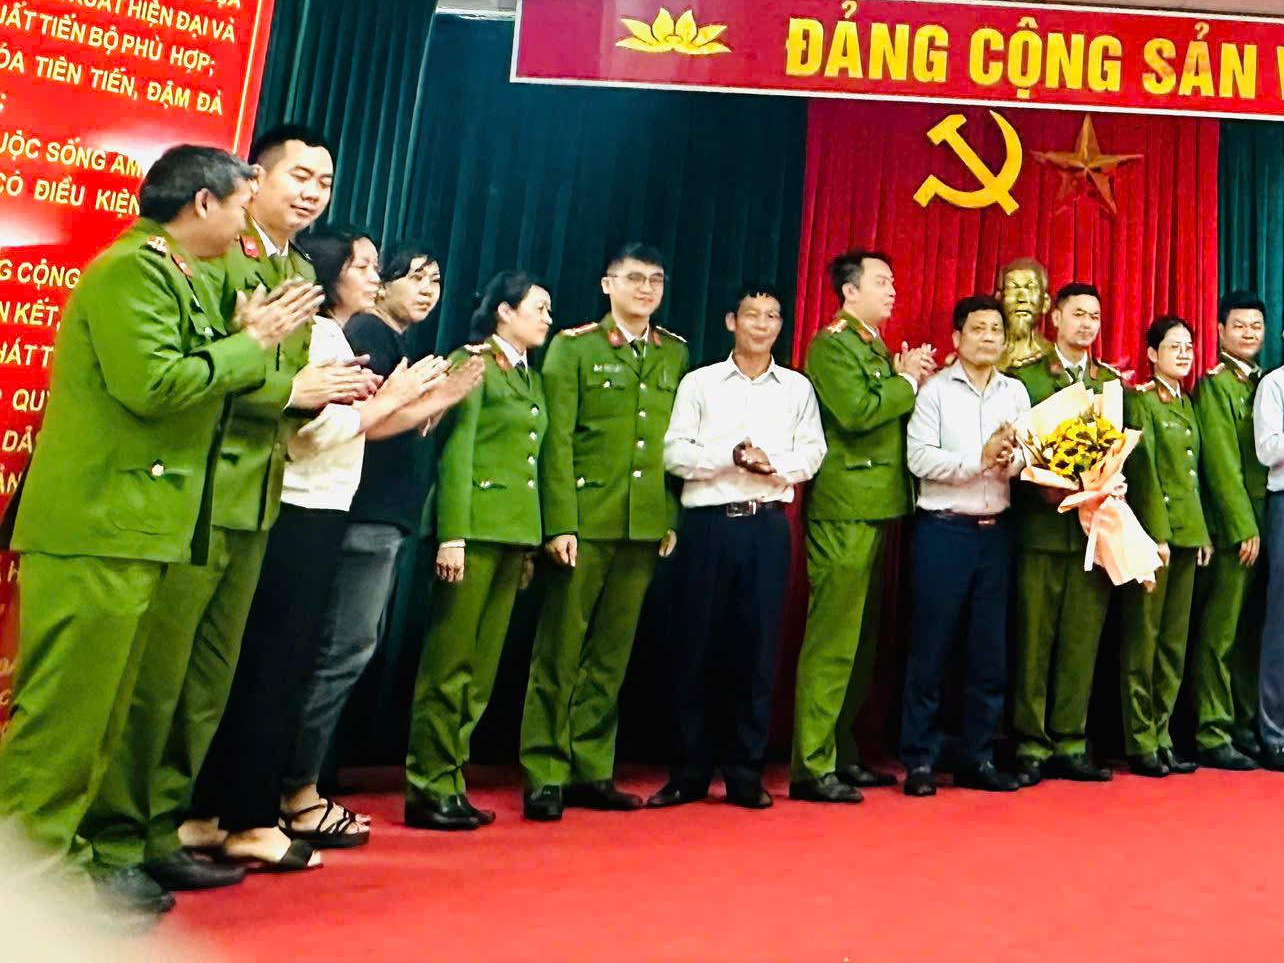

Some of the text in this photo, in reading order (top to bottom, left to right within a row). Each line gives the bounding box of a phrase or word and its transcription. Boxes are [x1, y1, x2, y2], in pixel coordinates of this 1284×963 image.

[40, 13, 86, 44] TIẾN
[88, 25, 119, 55] BỘ
[121, 34, 163, 61] PHÙ
[175, 11, 209, 39] ĐẠI
[211, 16, 235, 44] VÀ
[785, 0, 949, 84] ĐẢNG
[968, 16, 1122, 100] CỘNG
[1141, 21, 1257, 100] SẢN
[35, 55, 82, 85] TIÊN
[147, 80, 191, 109] ĐẬM
[196, 89, 222, 116] ĐÀ
[46, 136, 106, 171] SỐNG
[34, 175, 86, 207] ĐIỀU
[17, 258, 80, 290] CỘNG
